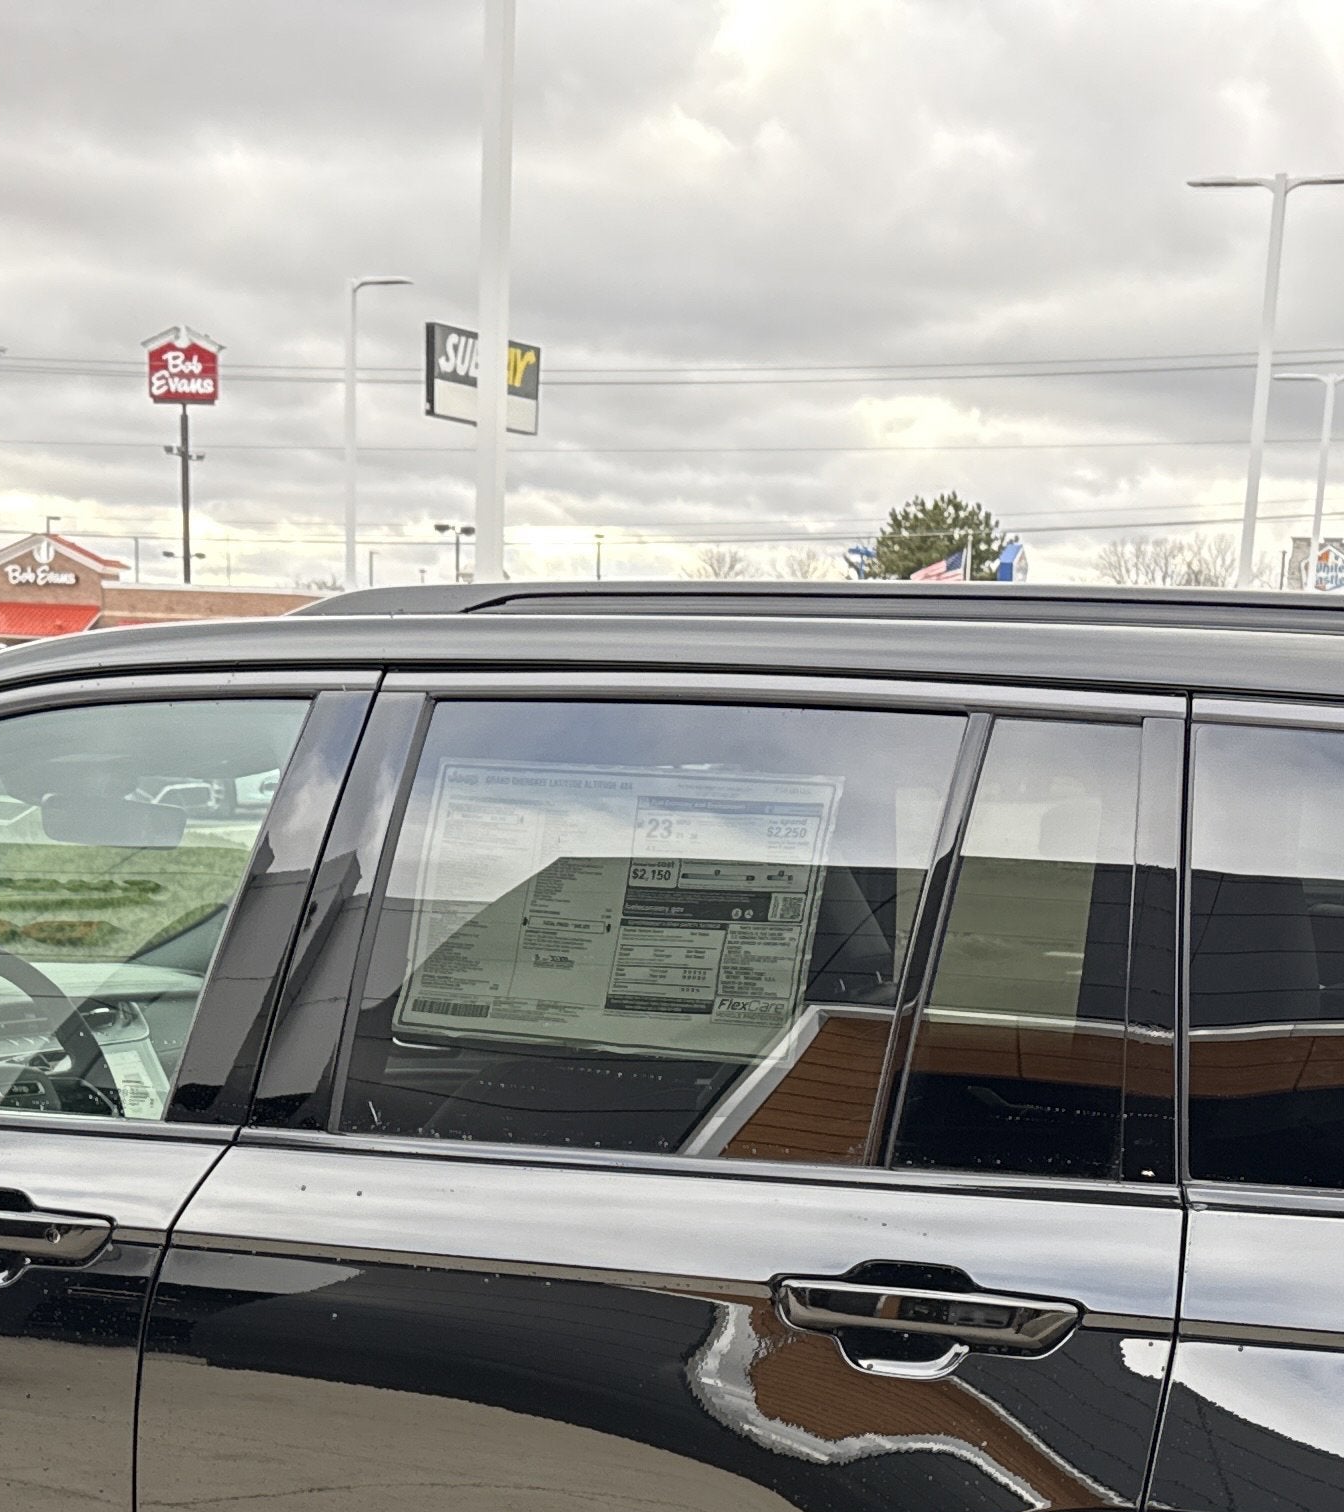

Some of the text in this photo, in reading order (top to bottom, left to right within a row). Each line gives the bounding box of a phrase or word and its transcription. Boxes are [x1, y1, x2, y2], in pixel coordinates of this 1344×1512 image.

[162, 351, 203, 374] Bob
[438, 333, 536, 388] SUY
[151, 369, 215, 396] Evans
[4, 564, 77, 586] Bob Evans
[646, 818, 673, 839] 23
[767, 827, 807, 839] $2,250
[632, 869, 671, 881] $2,150
[718, 998, 785, 1013] FlexCare
